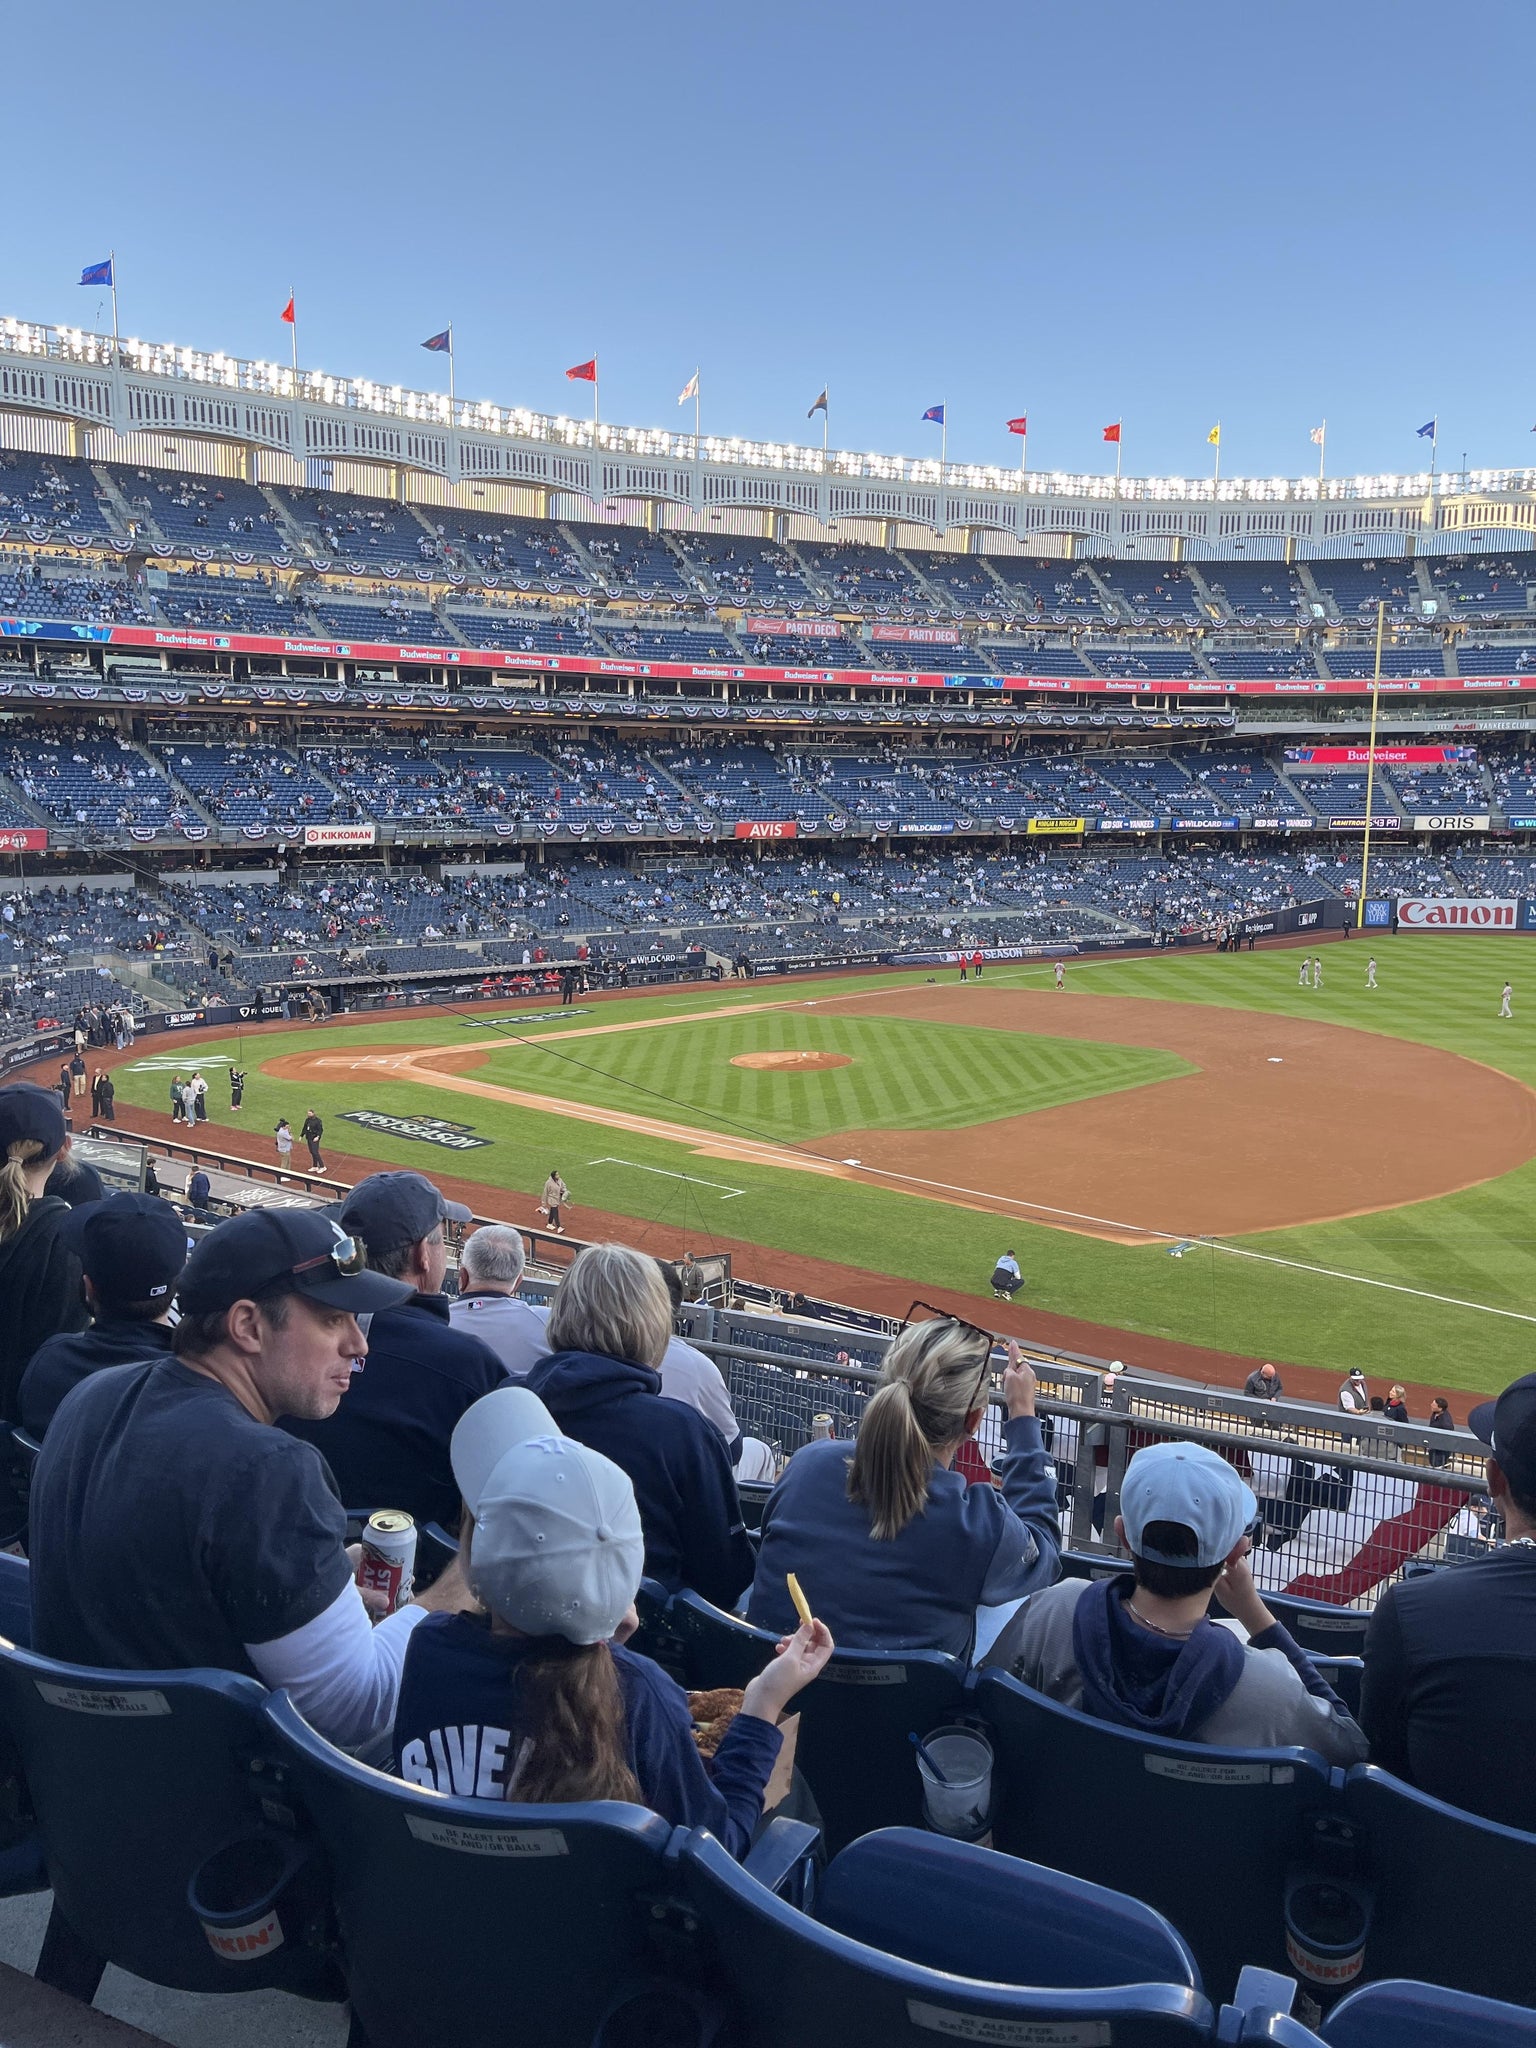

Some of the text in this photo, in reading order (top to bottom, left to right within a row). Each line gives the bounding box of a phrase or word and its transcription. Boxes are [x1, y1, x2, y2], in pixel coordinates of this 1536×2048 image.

[786, 622, 837, 636] PARTY DECK
[909, 630, 956, 642] PARTY DECK
[1478, 722, 1510, 730] YANKEES
[1511, 721, 1529, 730] CLUB
[1112, 820, 1123, 829] SOX
[1130, 820, 1155, 829] YANKEES
[1267, 819, 1279, 828] SOX
[1286, 819, 1312, 828] YANKEES
[1386, 819, 1398, 828] PM
[1429, 816, 1474, 829] ORIS
[322, 831, 372, 840] KIKKOMAN
[749, 823, 784, 837] AVIS
[1367, 908, 1387, 917] YORK
[1369, 903, 1387, 911] NEW
[1369, 914, 1386, 922] LIFE
[1398, 902, 1514, 925] Canon
[180, 1012, 197, 1022] SHOP
[343, 1111, 485, 1149] POSTSEASON
[402, 1725, 536, 1800] RIVE
[432, 1832, 541, 1852] BATS AND/OR BALLS
[446, 1829, 519, 1844] BE ALERT FOR
